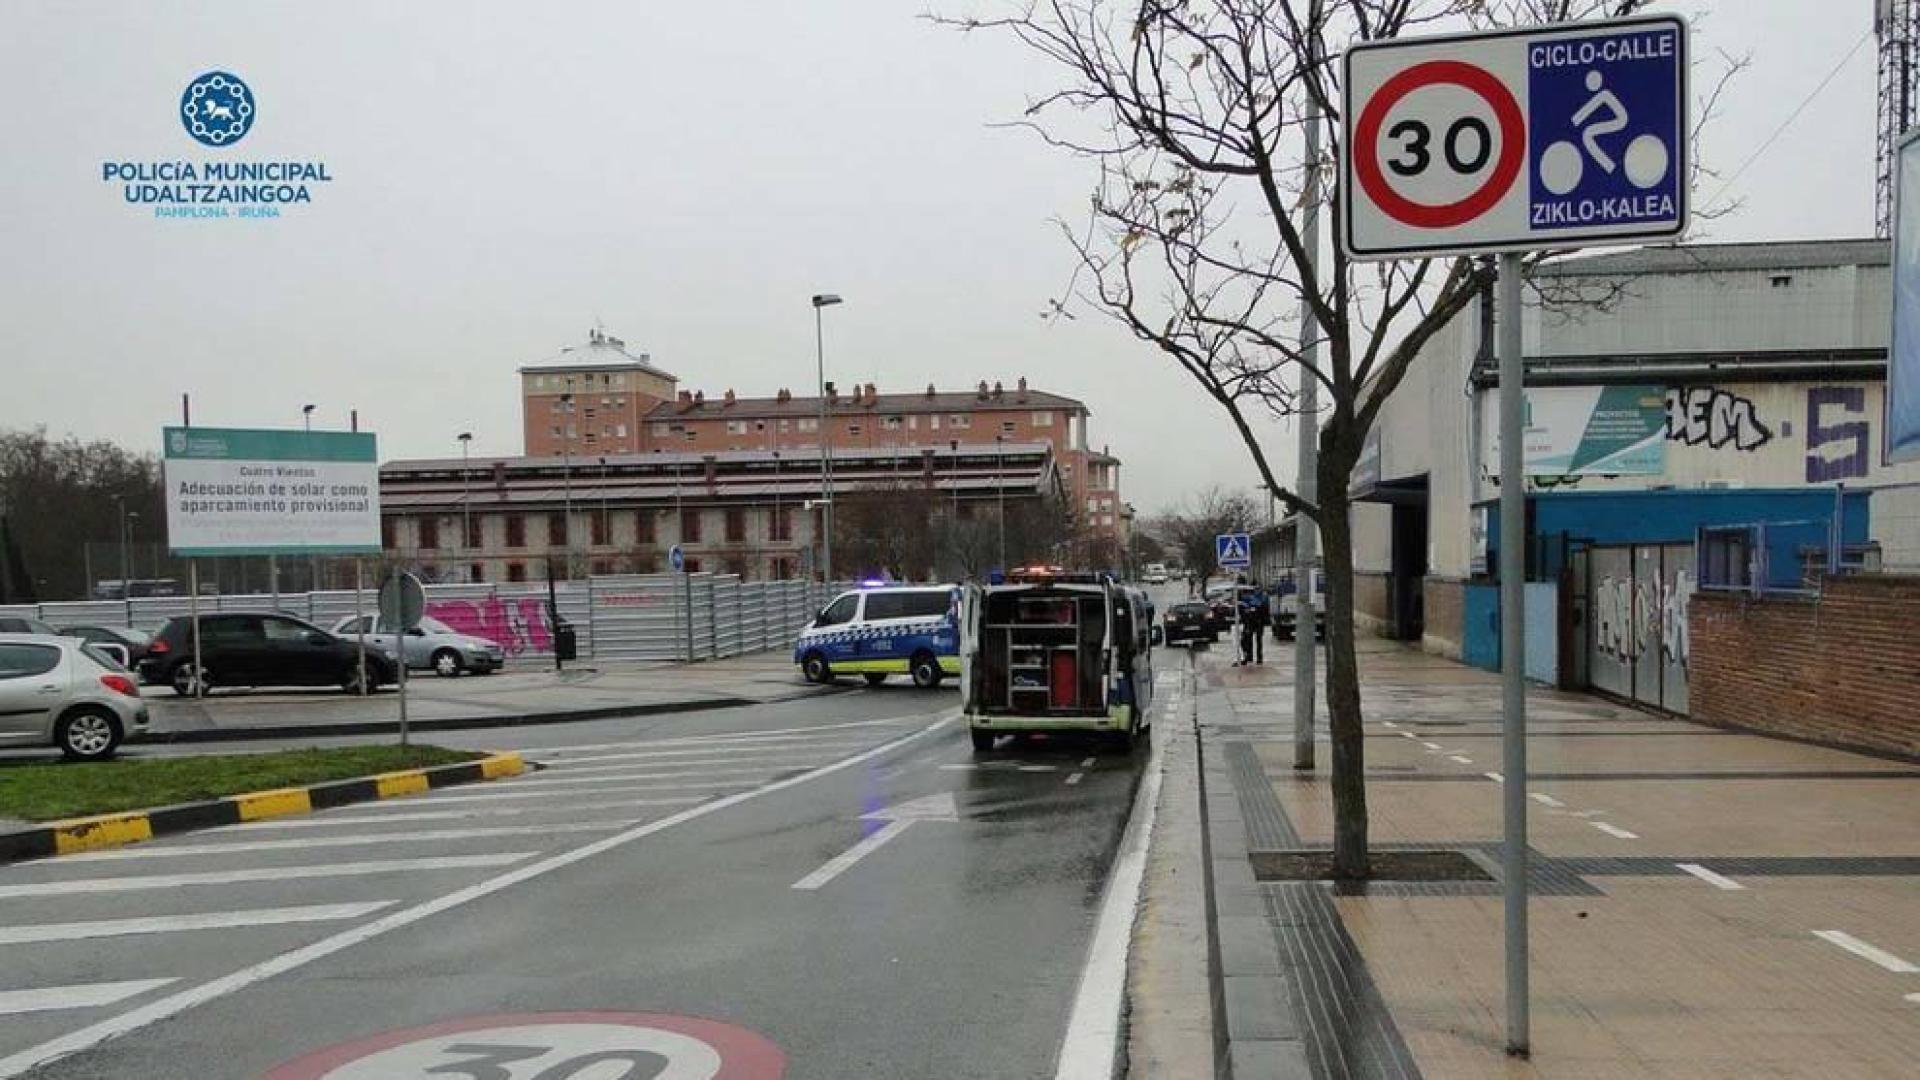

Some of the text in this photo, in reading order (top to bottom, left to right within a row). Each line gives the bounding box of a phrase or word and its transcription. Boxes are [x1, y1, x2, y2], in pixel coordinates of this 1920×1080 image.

[1531, 34, 1673, 68] CICLO-CALLE
[1387, 116, 1492, 177] 30
[1532, 195, 1675, 224] ZIKLO-KALEA
[180, 481, 368, 497] Adecuación de solar como
[181, 498, 369, 515] aparcamiento provisional
